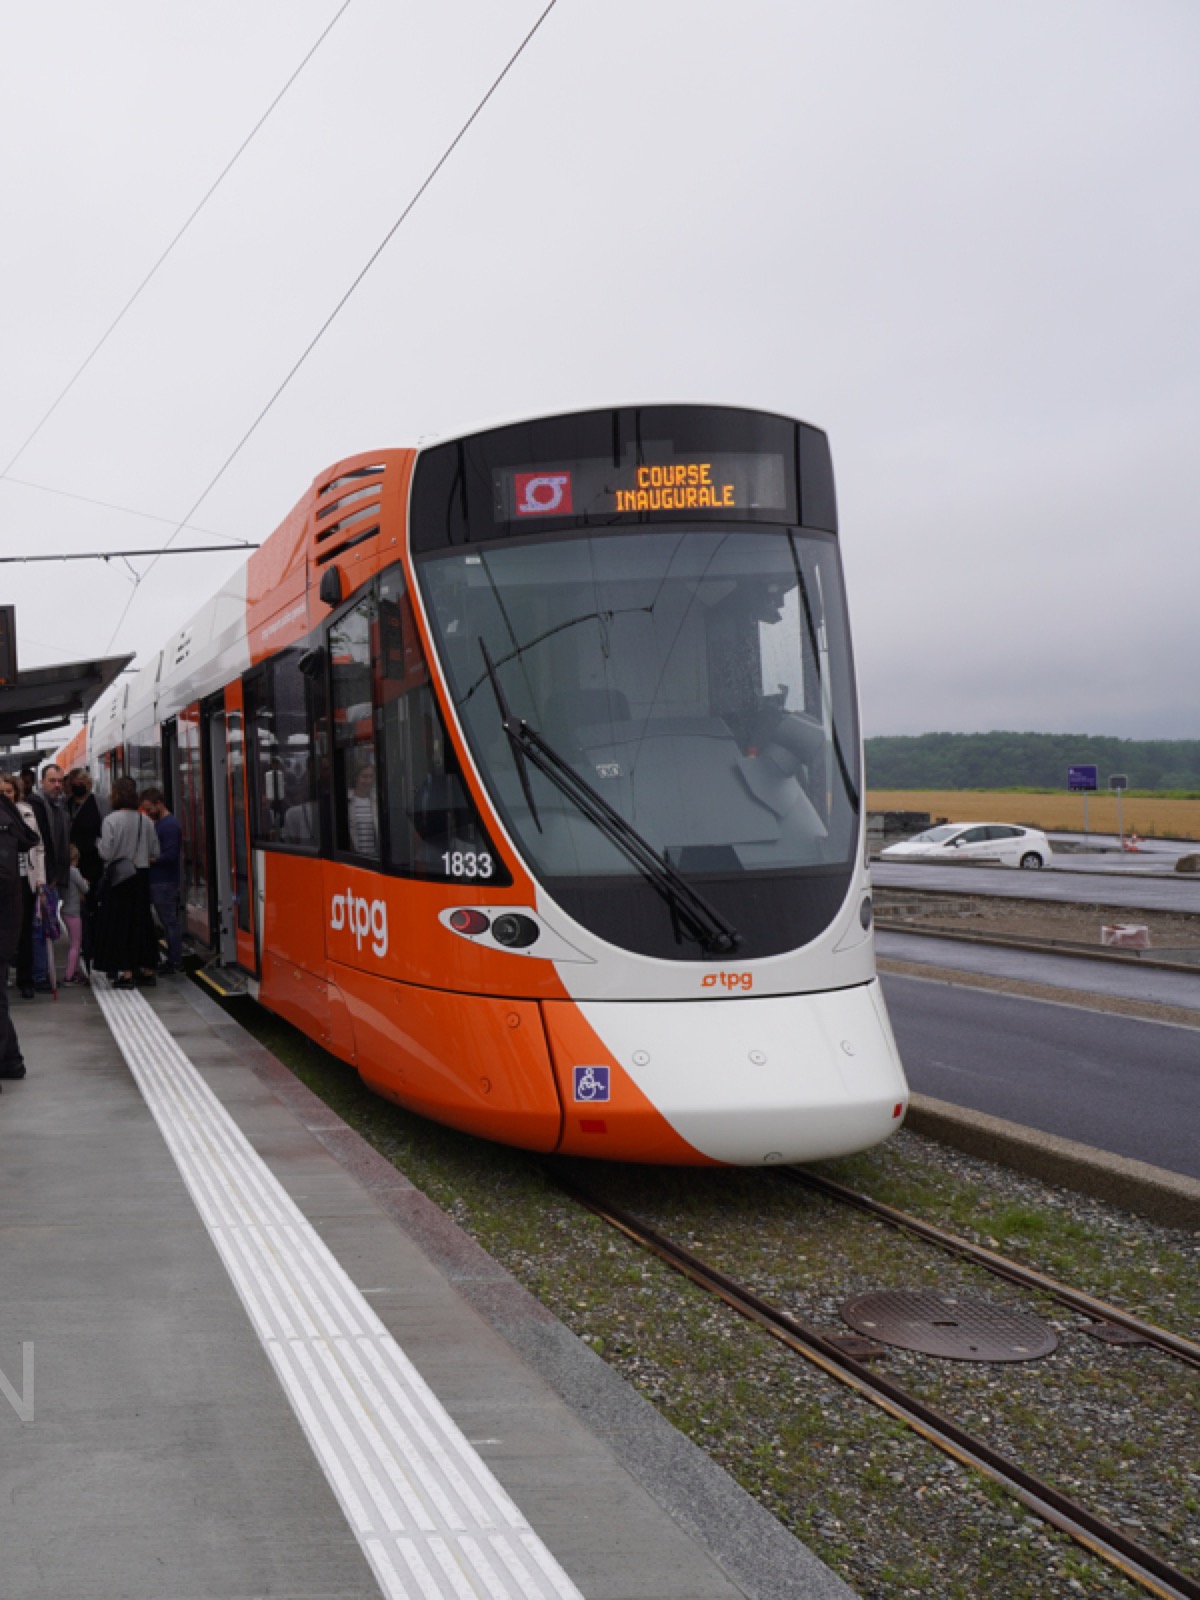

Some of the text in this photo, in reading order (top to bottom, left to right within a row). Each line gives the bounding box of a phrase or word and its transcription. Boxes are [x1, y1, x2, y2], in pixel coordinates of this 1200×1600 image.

[637, 463, 712, 488] COURSE
[615, 485, 735, 512] INAUGURALE
[441, 851, 493, 879] 1833
